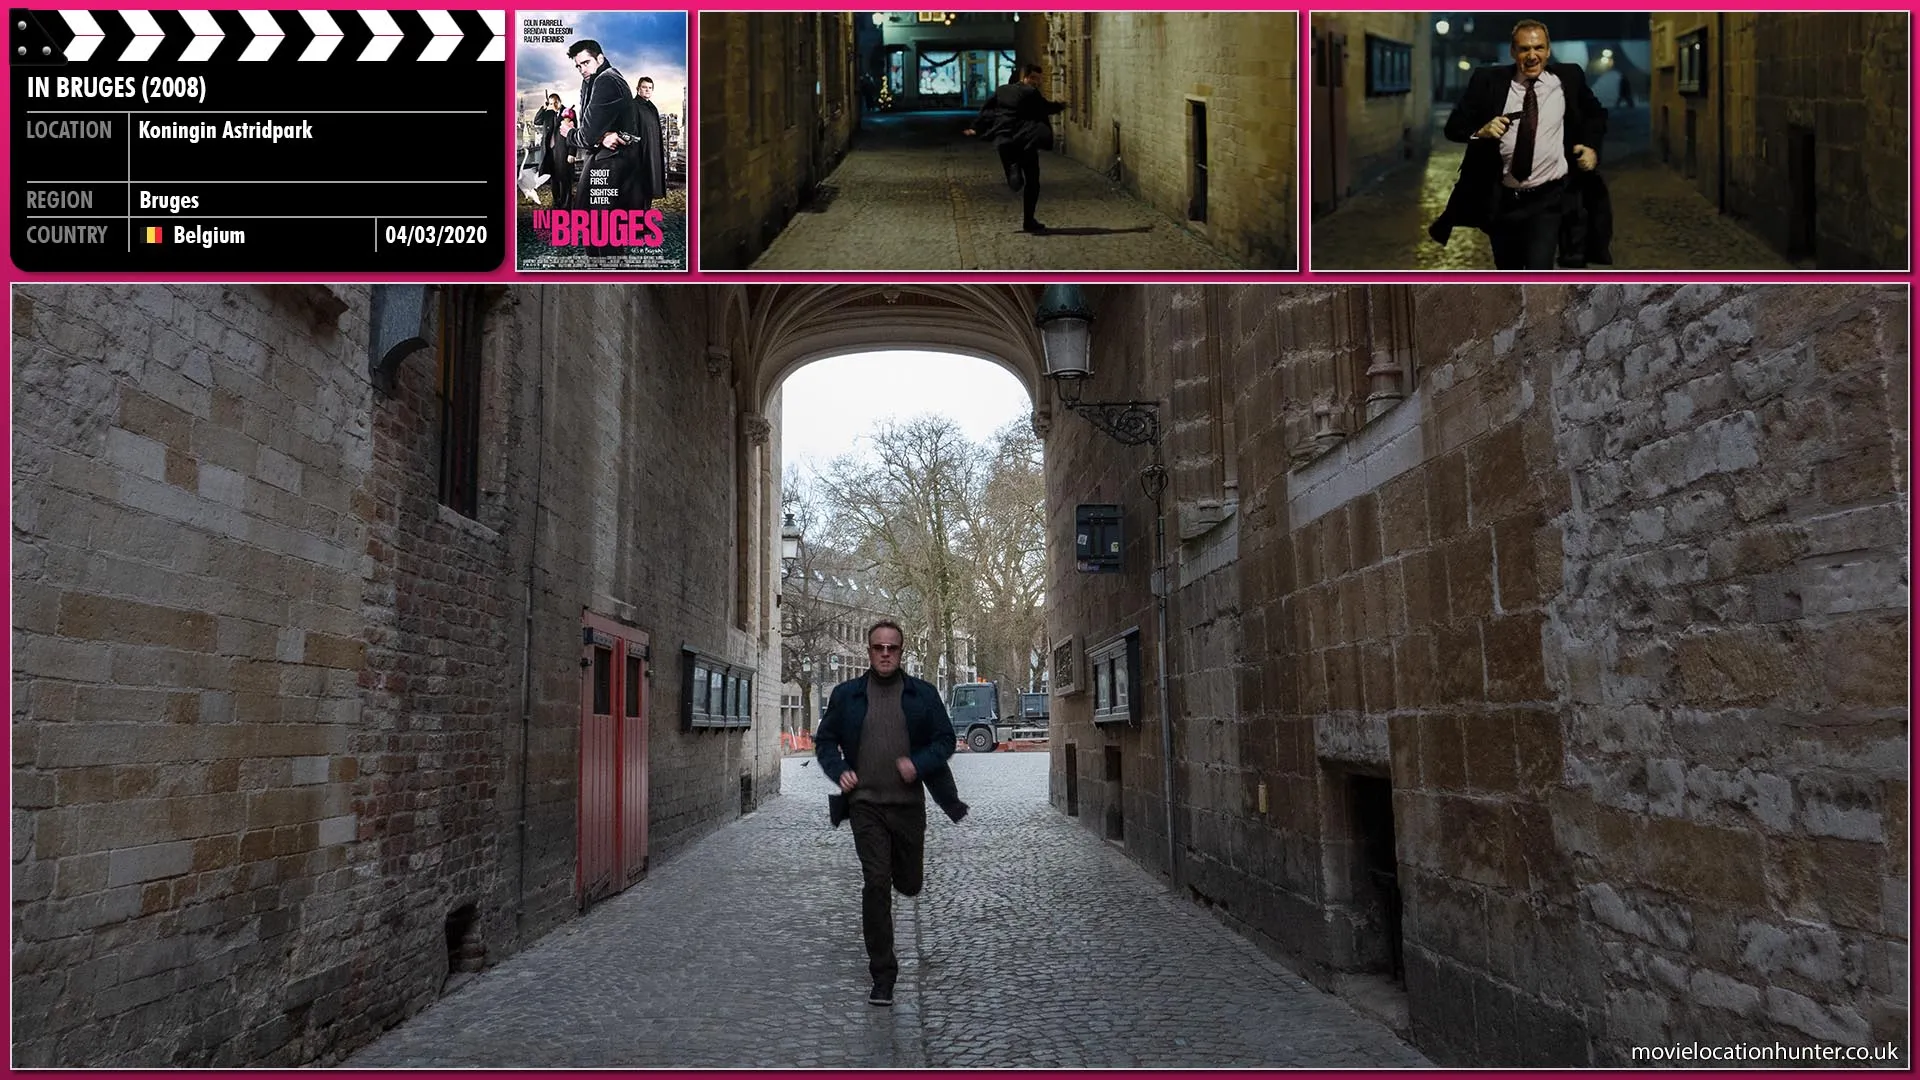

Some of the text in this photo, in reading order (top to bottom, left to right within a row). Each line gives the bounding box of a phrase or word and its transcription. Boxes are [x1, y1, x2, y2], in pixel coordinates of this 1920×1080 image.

[523, 27, 573, 35] BRENDAN GLEESON
[523, 35, 565, 43] RALPH FIENNES
[590, 169, 610, 177] SHOOT
[590, 188, 619, 197] SIGHTSEE
[590, 197, 611, 205] LATER.
[532, 208, 664, 248] IN BRUGES
